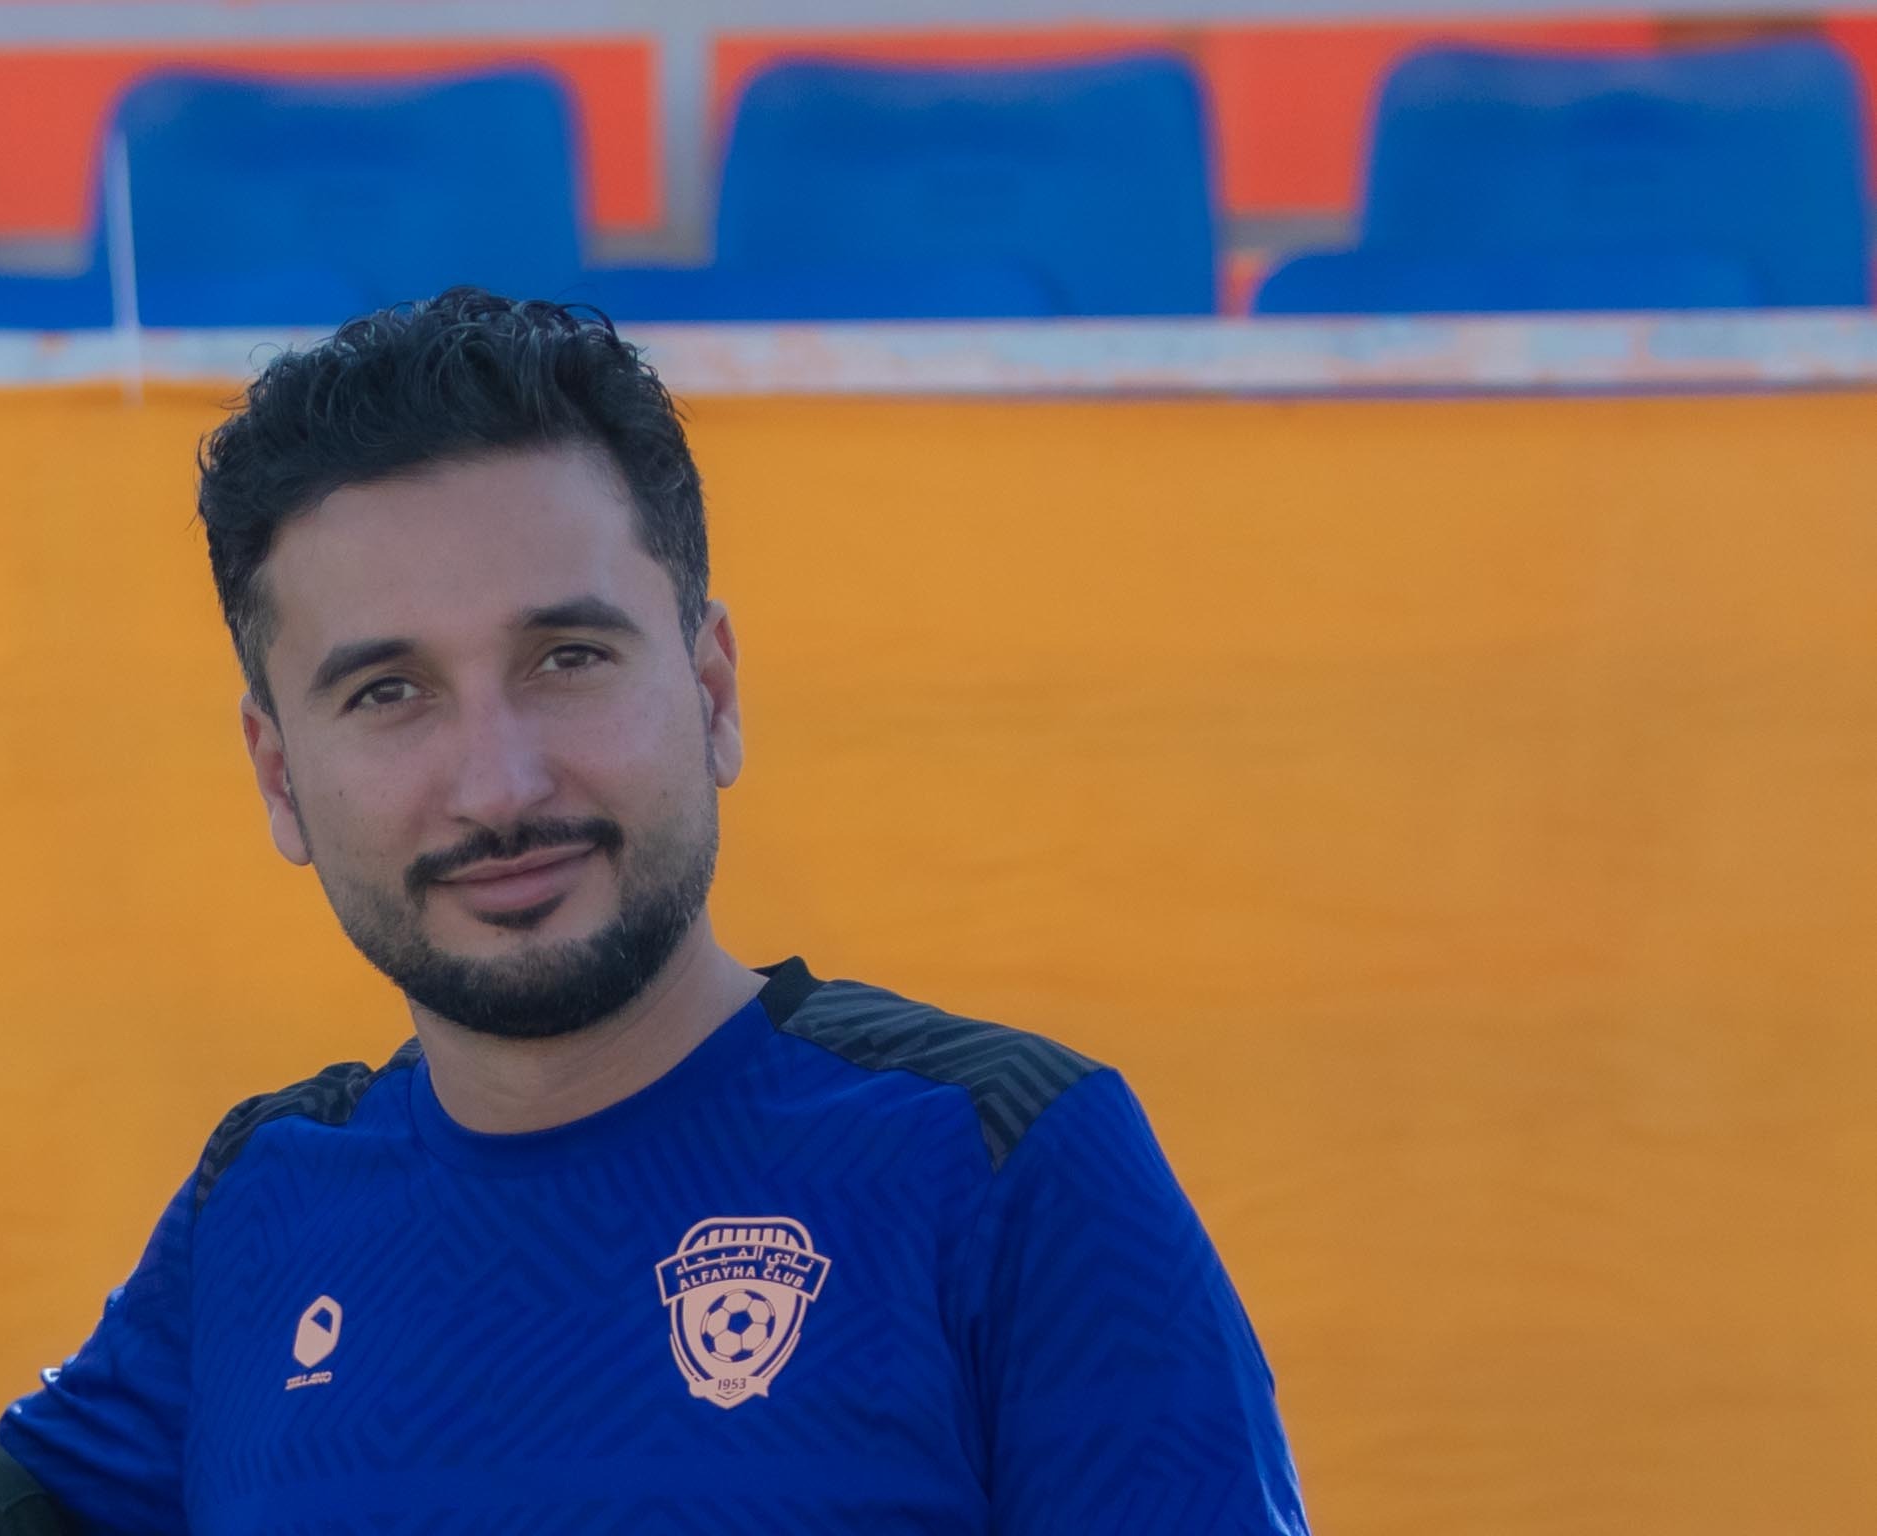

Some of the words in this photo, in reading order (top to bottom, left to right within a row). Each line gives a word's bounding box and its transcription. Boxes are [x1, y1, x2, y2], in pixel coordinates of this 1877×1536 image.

[676, 1246, 764, 1275] الفيحاء
[766, 1252, 814, 1272] نادي
[679, 1266, 756, 1291] ALFAYHA
[762, 1267, 805, 1288] CLUB
[717, 1377, 747, 1391] 1953
